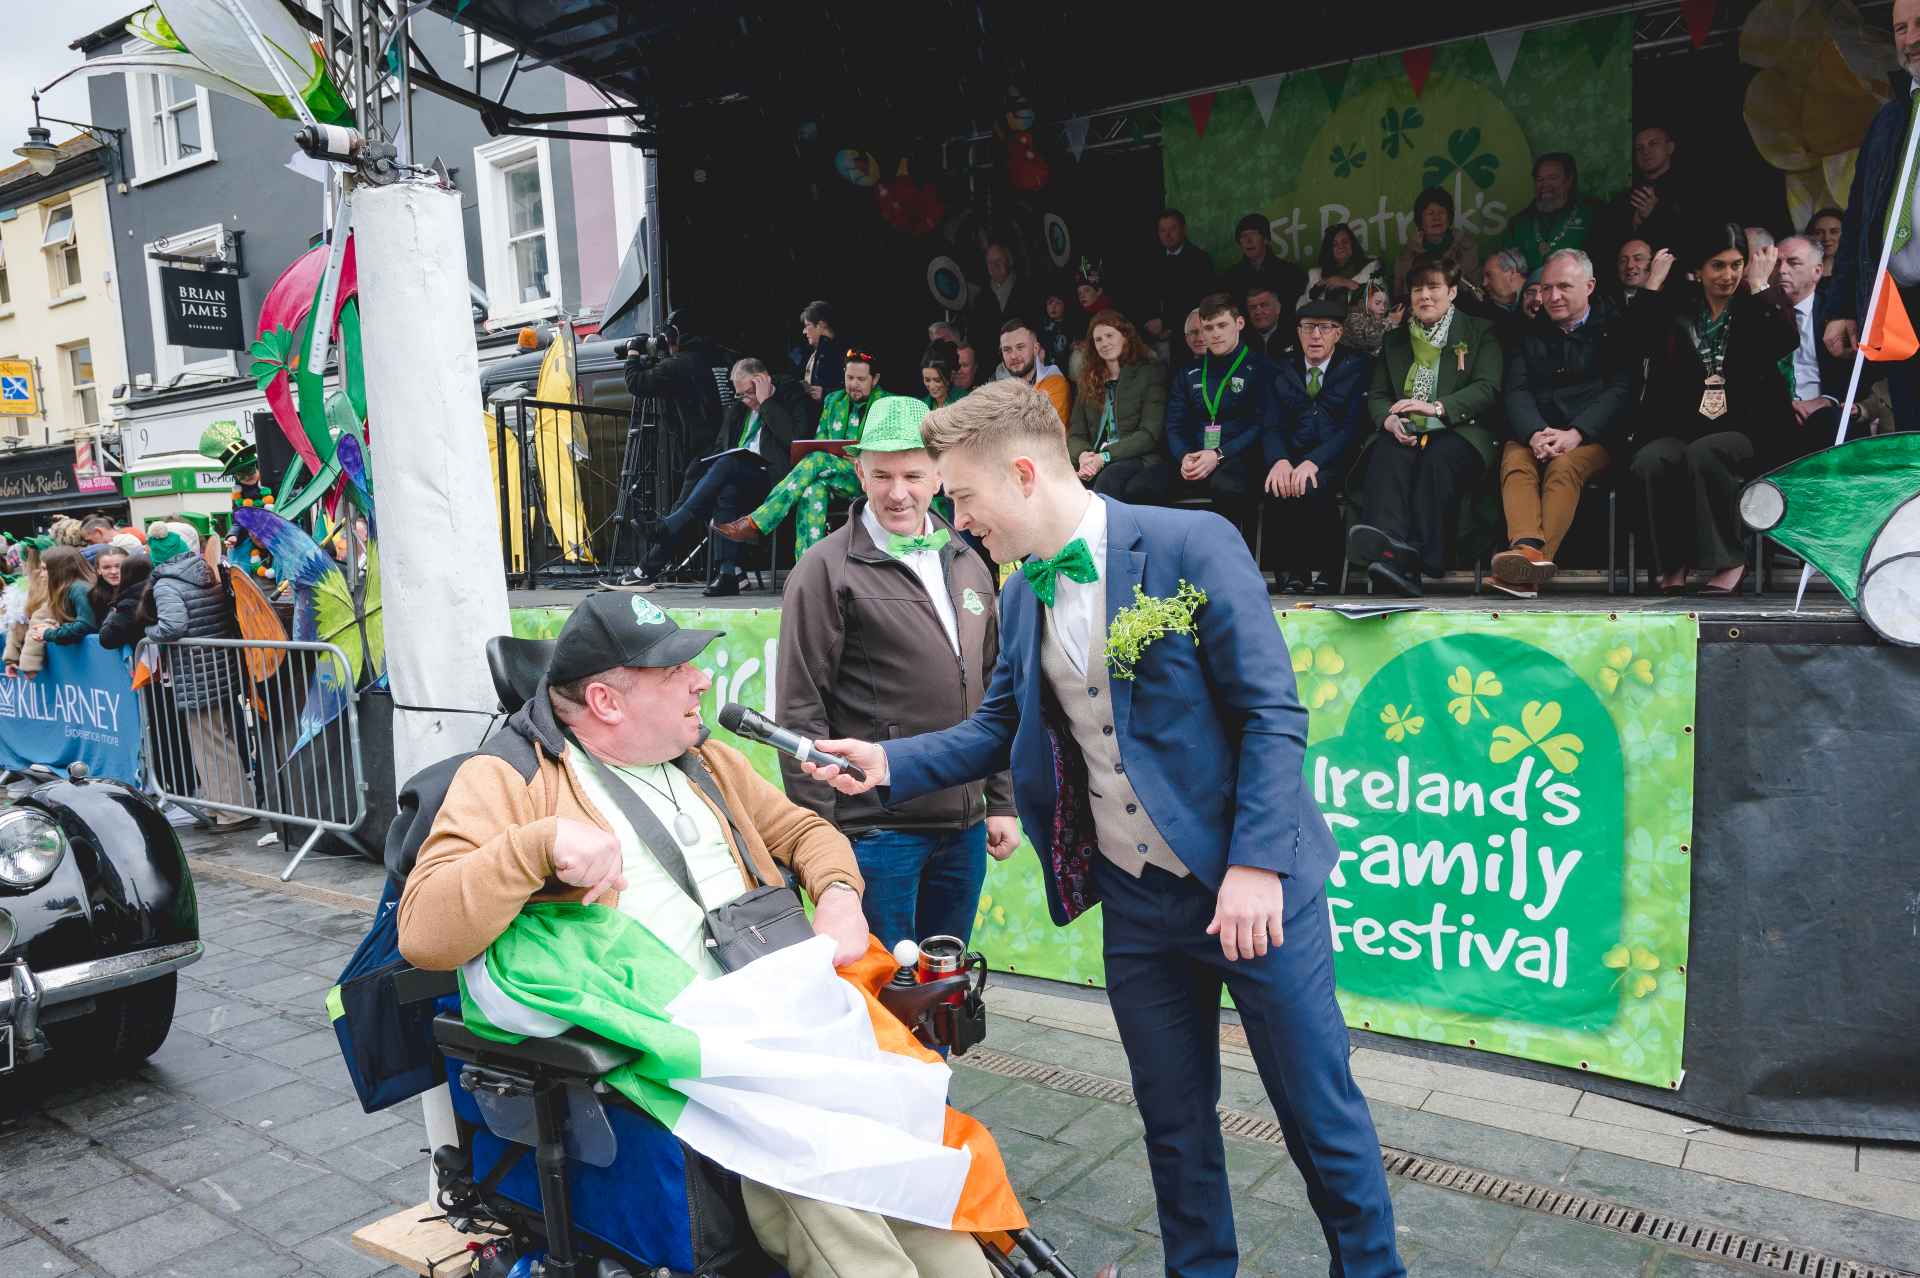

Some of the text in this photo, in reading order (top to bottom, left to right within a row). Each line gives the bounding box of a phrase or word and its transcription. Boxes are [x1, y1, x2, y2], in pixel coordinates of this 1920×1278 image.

[1320, 171, 1507, 250] Patrk's
[179, 286, 225, 301] BRIAN
[181, 303, 228, 318] JAMES
[17, 677, 120, 732] KILLARNEY
[1314, 755, 1581, 826] Ireland's
[1323, 812, 1583, 921] Family
[1327, 898, 1568, 988] Festival
